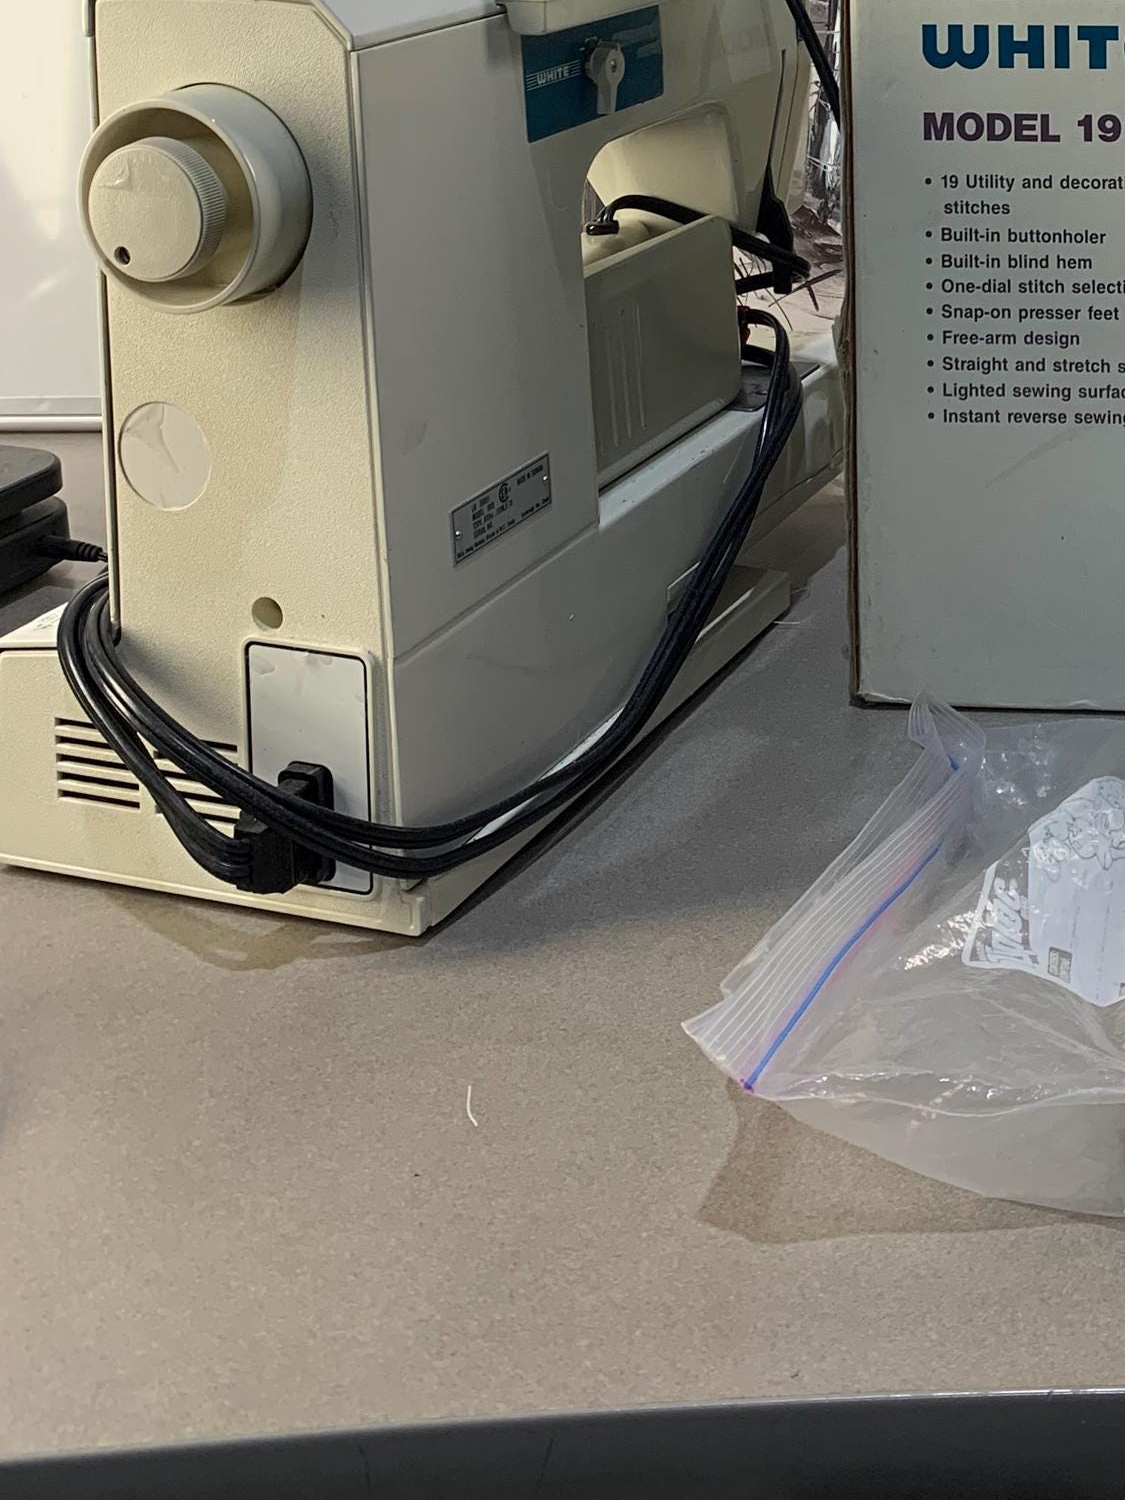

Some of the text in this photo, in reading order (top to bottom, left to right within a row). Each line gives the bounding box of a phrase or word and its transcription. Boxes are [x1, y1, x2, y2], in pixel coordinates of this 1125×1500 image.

[536, 66, 570, 85] WHITE
[923, 112, 1061, 142] MODEL
[941, 174, 959, 189] 19
[966, 174, 1015, 193] Utility
[1022, 175, 1053, 190] and
[943, 200, 1011, 215] stitches
[941, 227, 1107, 245] Built-in buttonholer
[941, 253, 1093, 270] Built-in blind hem
[941, 278, 1011, 294] One-dial
[1018, 279, 1065, 294] stitch
[941, 304, 1120, 323] Snap-on presser feet
[942, 330, 1080, 350] Free-arm design
[942, 356, 1009, 375] Straight
[1015, 357, 1046, 373] and
[1053, 357, 1111, 374] stretch
[942, 382, 1006, 401] Lighted
[1013, 384, 1072, 402] sewing
[943, 408, 1001, 425] Instant
[1008, 410, 1068, 426] reverse
